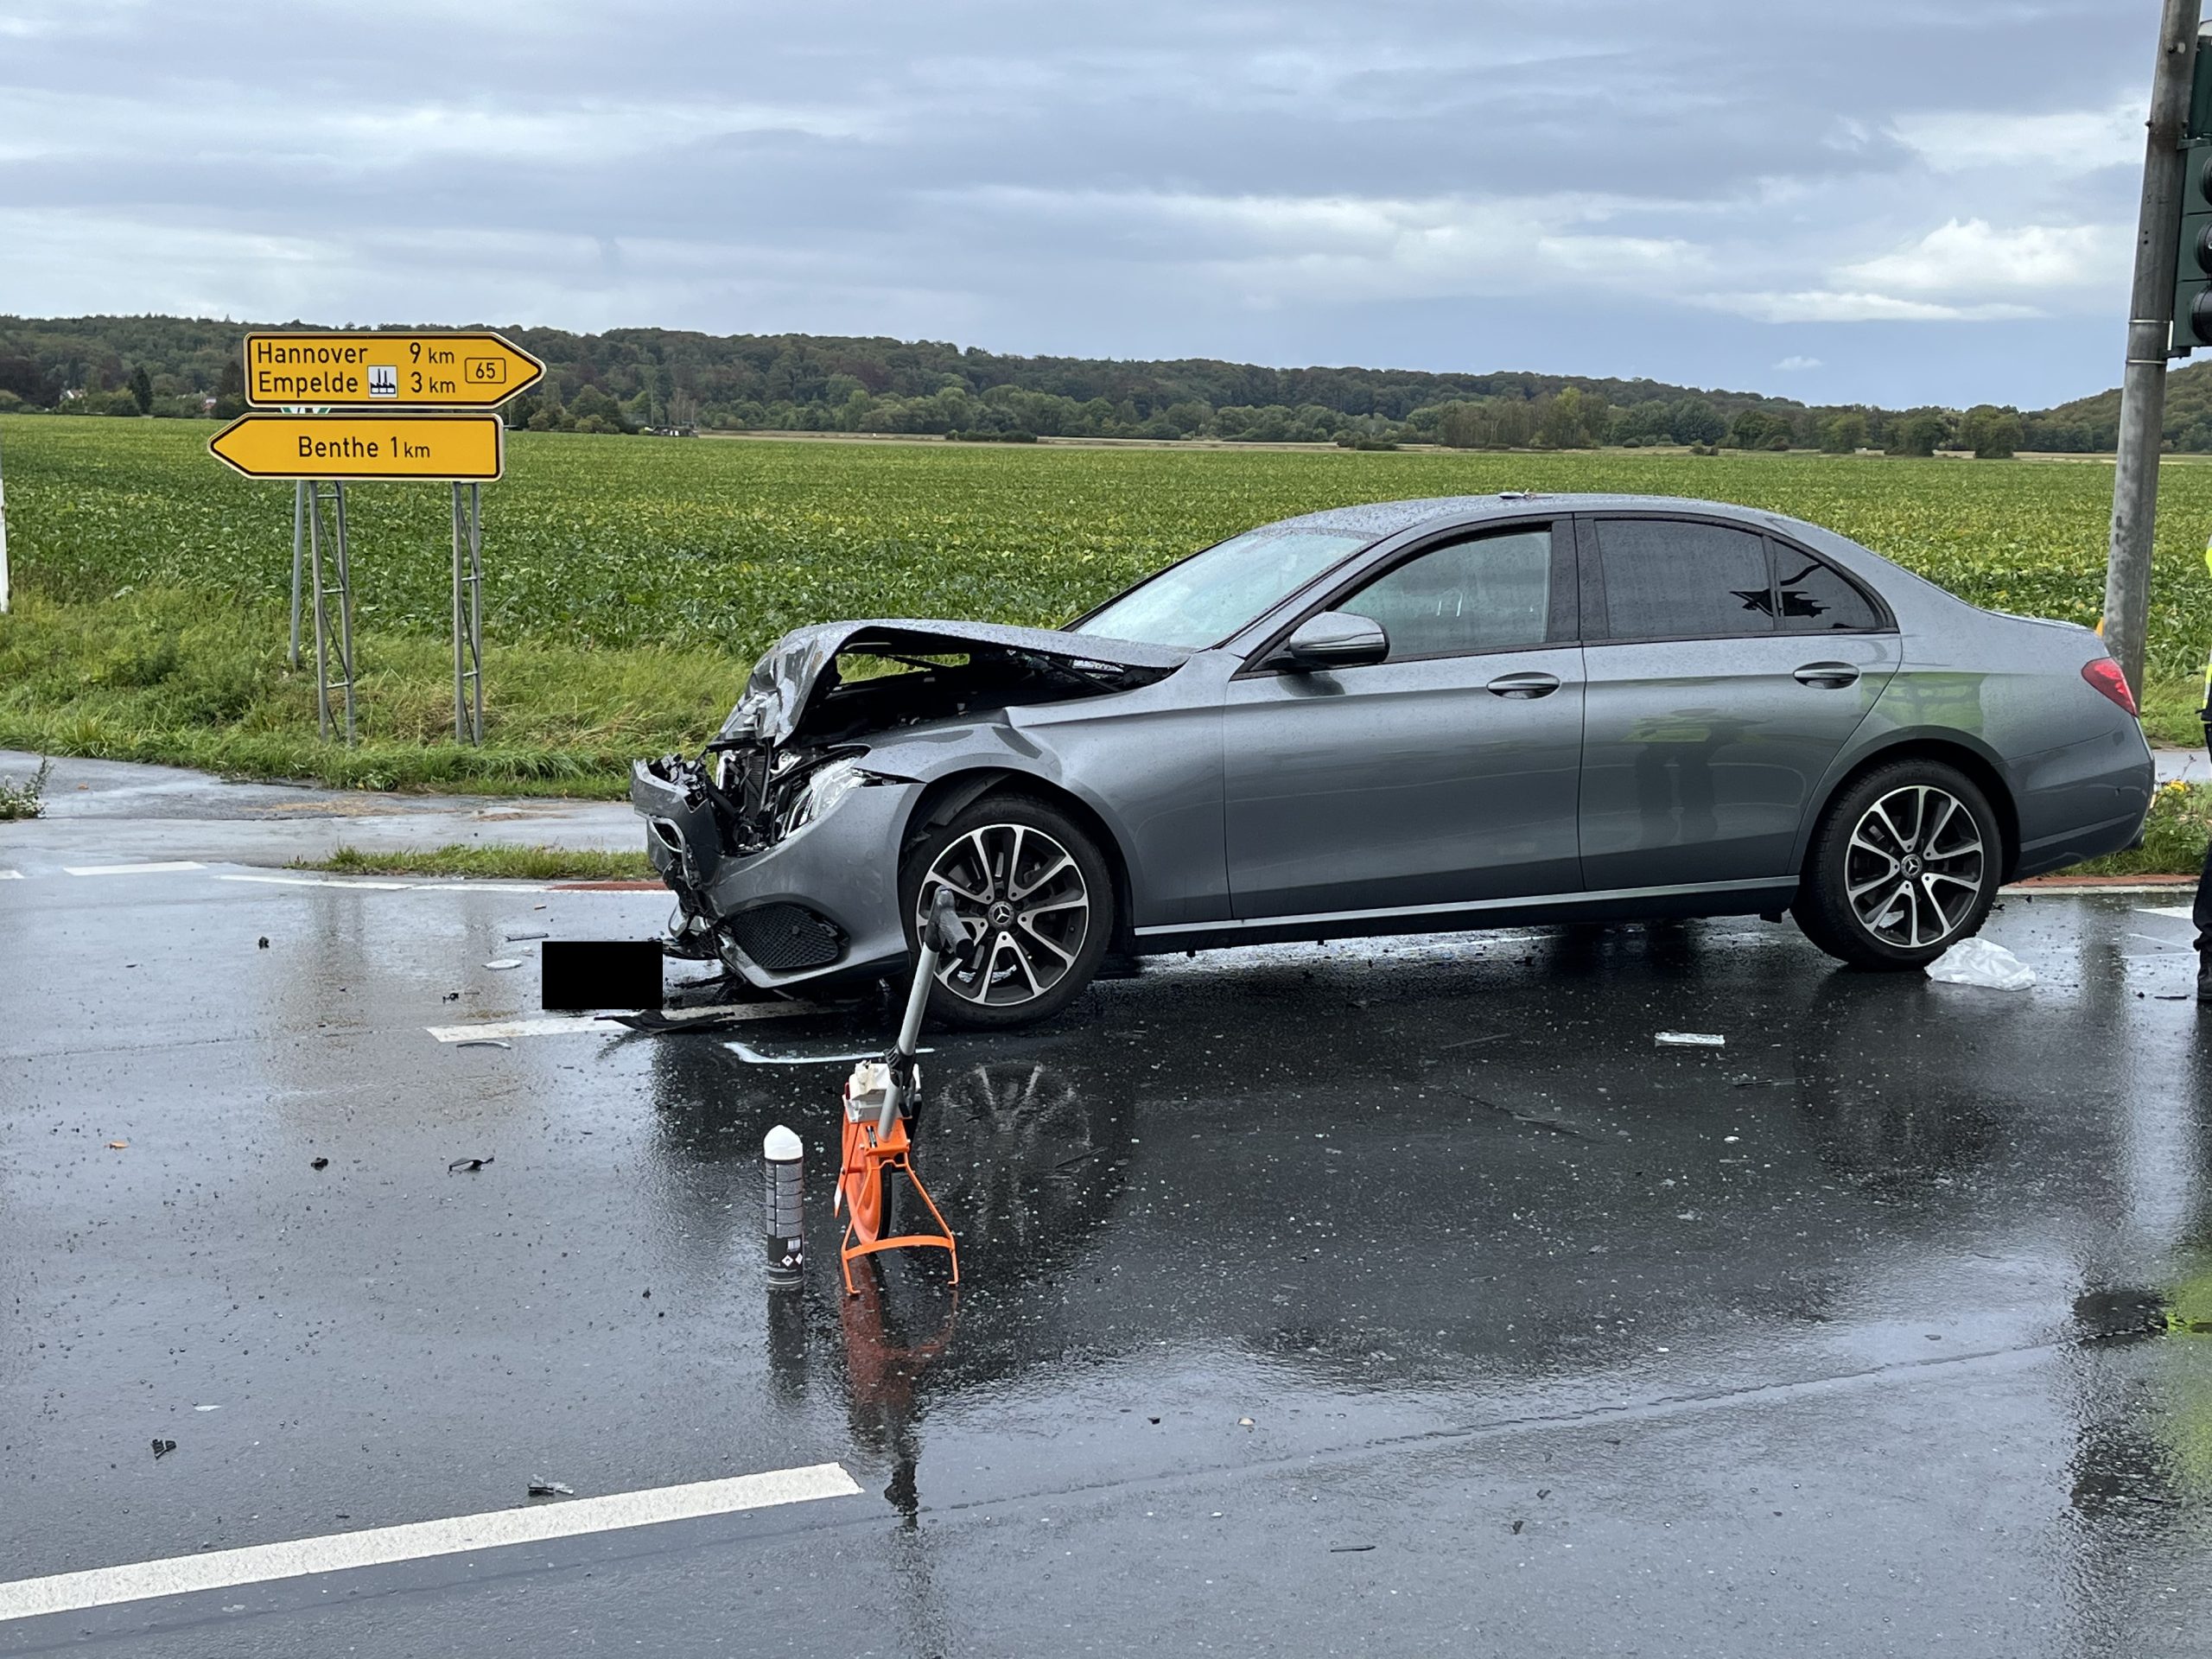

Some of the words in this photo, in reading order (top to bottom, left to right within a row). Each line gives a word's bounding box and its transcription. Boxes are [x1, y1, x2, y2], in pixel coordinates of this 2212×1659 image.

[257, 342, 368, 364] Hannover
[410, 342, 422, 364] 9
[429, 347, 454, 364] km
[475, 363, 496, 378] 65
[259, 372, 359, 397] Empelde
[410, 372, 423, 393] 3
[429, 377, 455, 393] km
[299, 436, 378, 458] Benthe
[391, 436, 397, 458] 1
[404, 442, 430, 458] km
